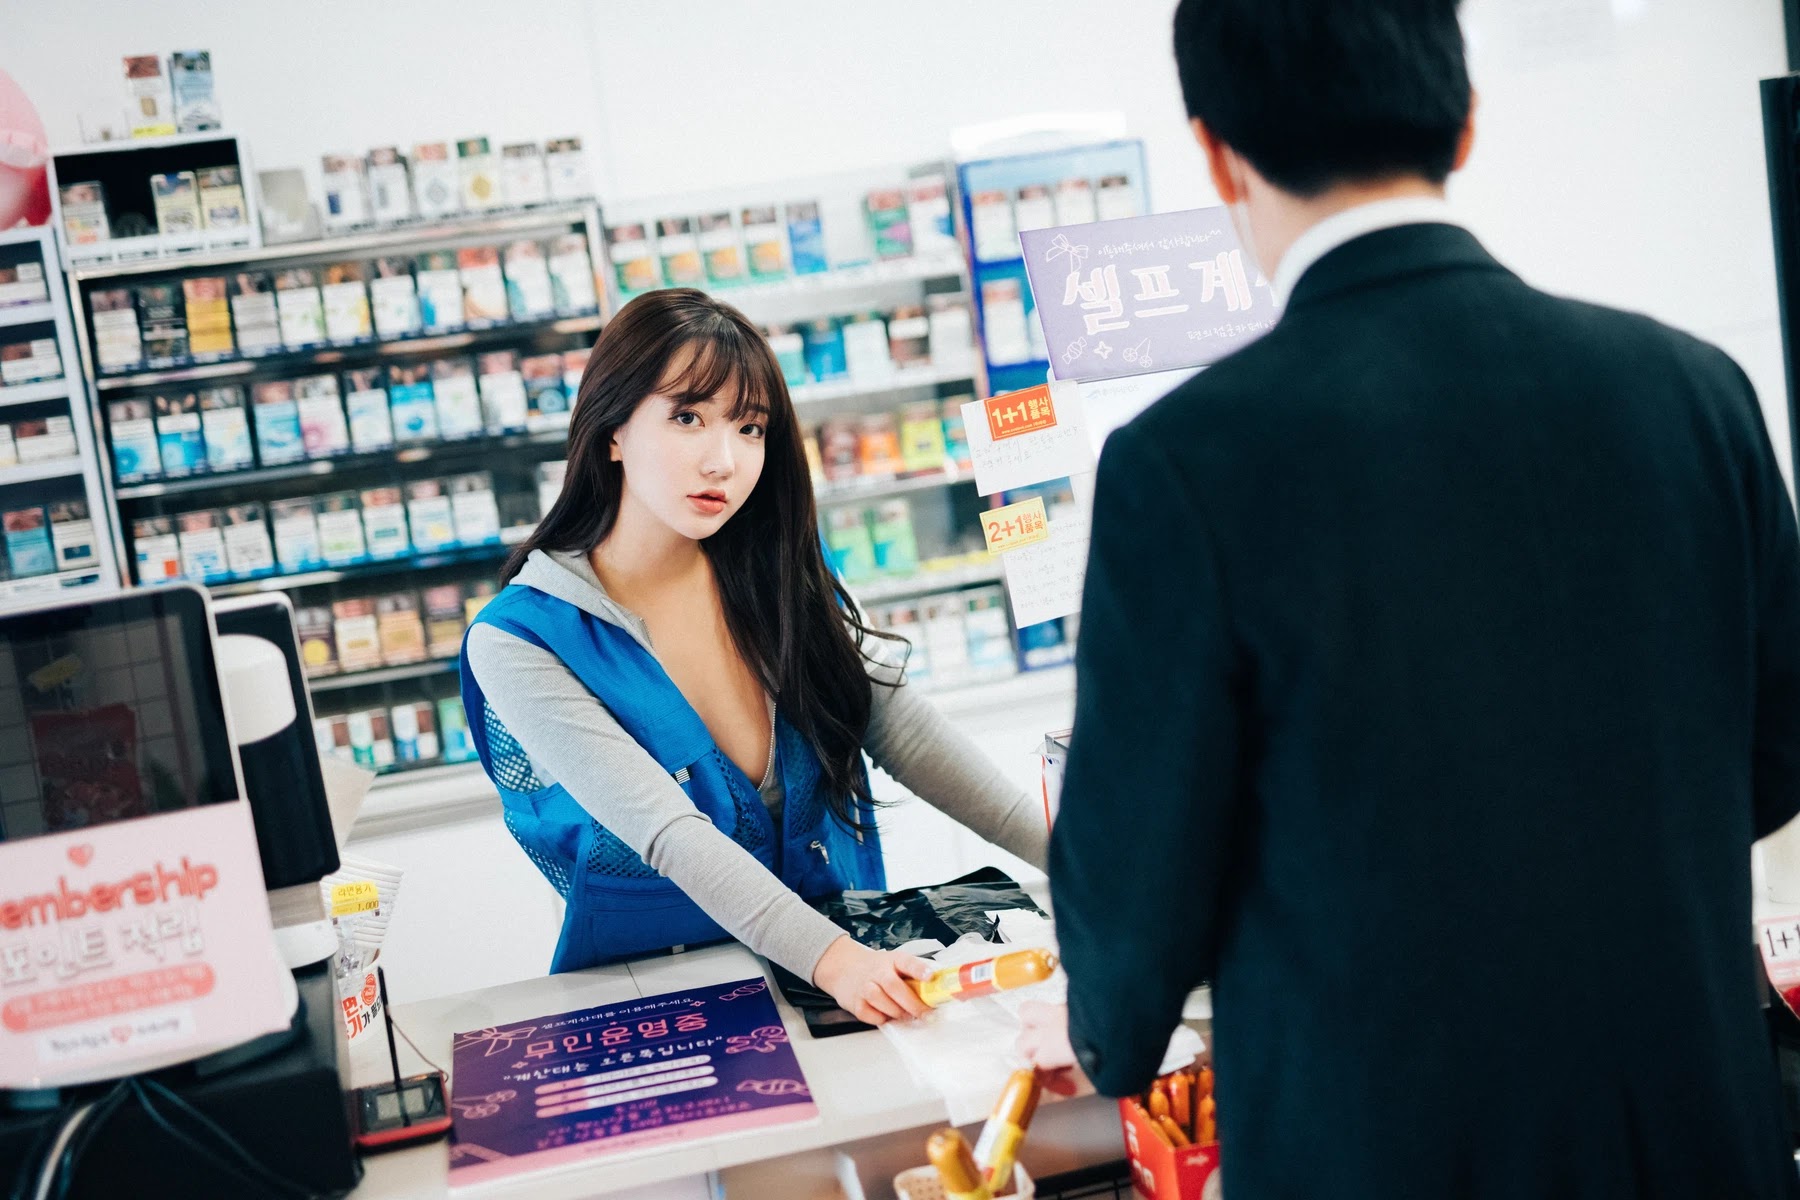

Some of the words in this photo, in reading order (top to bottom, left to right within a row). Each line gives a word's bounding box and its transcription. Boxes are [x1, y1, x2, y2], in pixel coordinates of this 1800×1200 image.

[991, 401, 1029, 428] 1+1
[1028, 396, 1049, 411] 행사
[1030, 406, 1051, 420] 품목
[988, 515, 1025, 543] 2+1
[1022, 511, 1042, 524] 행사
[1024, 520, 1043, 534] 품목
[345, 1011, 371, 1040] 기가
[541, 1009, 617, 1030] 셀프계산대를
[618, 997, 694, 1017] 이용해주세요
[524, 1012, 708, 1060] 무인운영중
